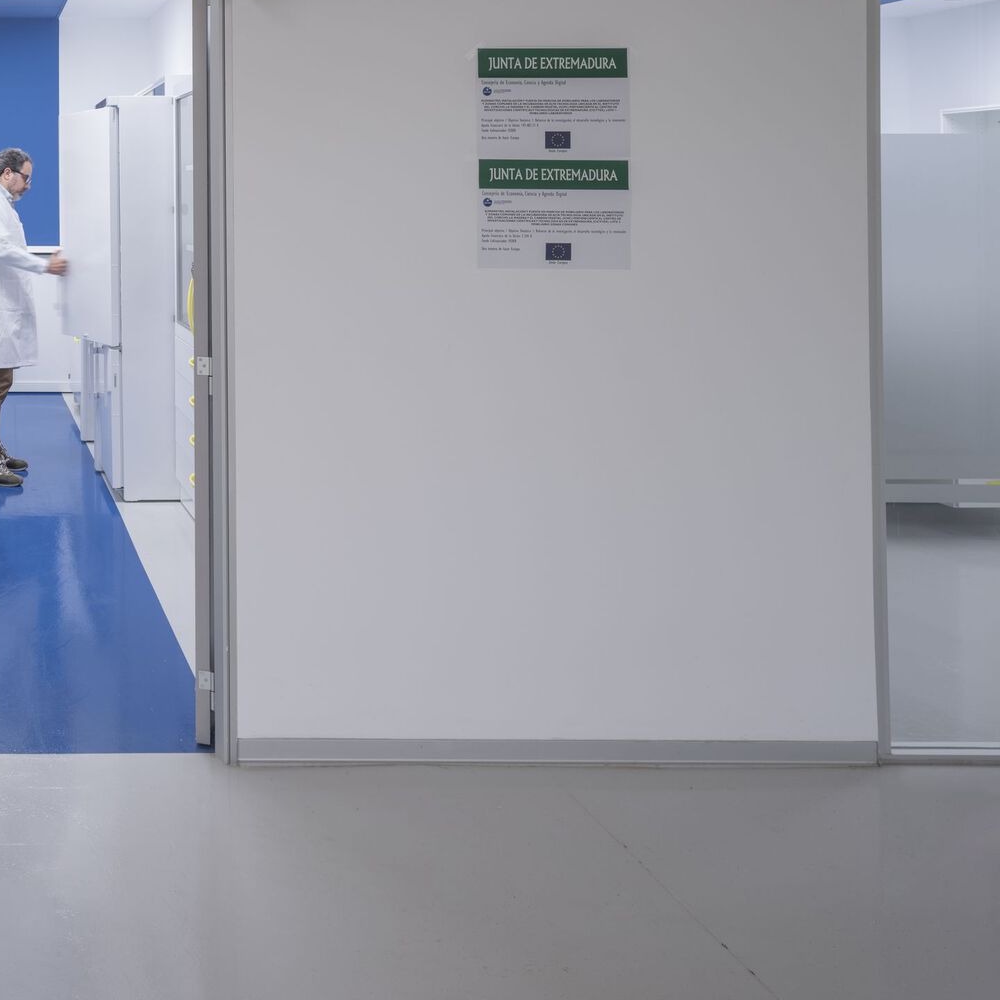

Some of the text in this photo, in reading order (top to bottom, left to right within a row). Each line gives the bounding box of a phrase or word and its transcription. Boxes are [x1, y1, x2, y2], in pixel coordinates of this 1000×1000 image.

[488, 56, 617, 71] JUNTA DE EXTREMADURA
[489, 167, 618, 182] JUNTA DE EXTREMADURA
